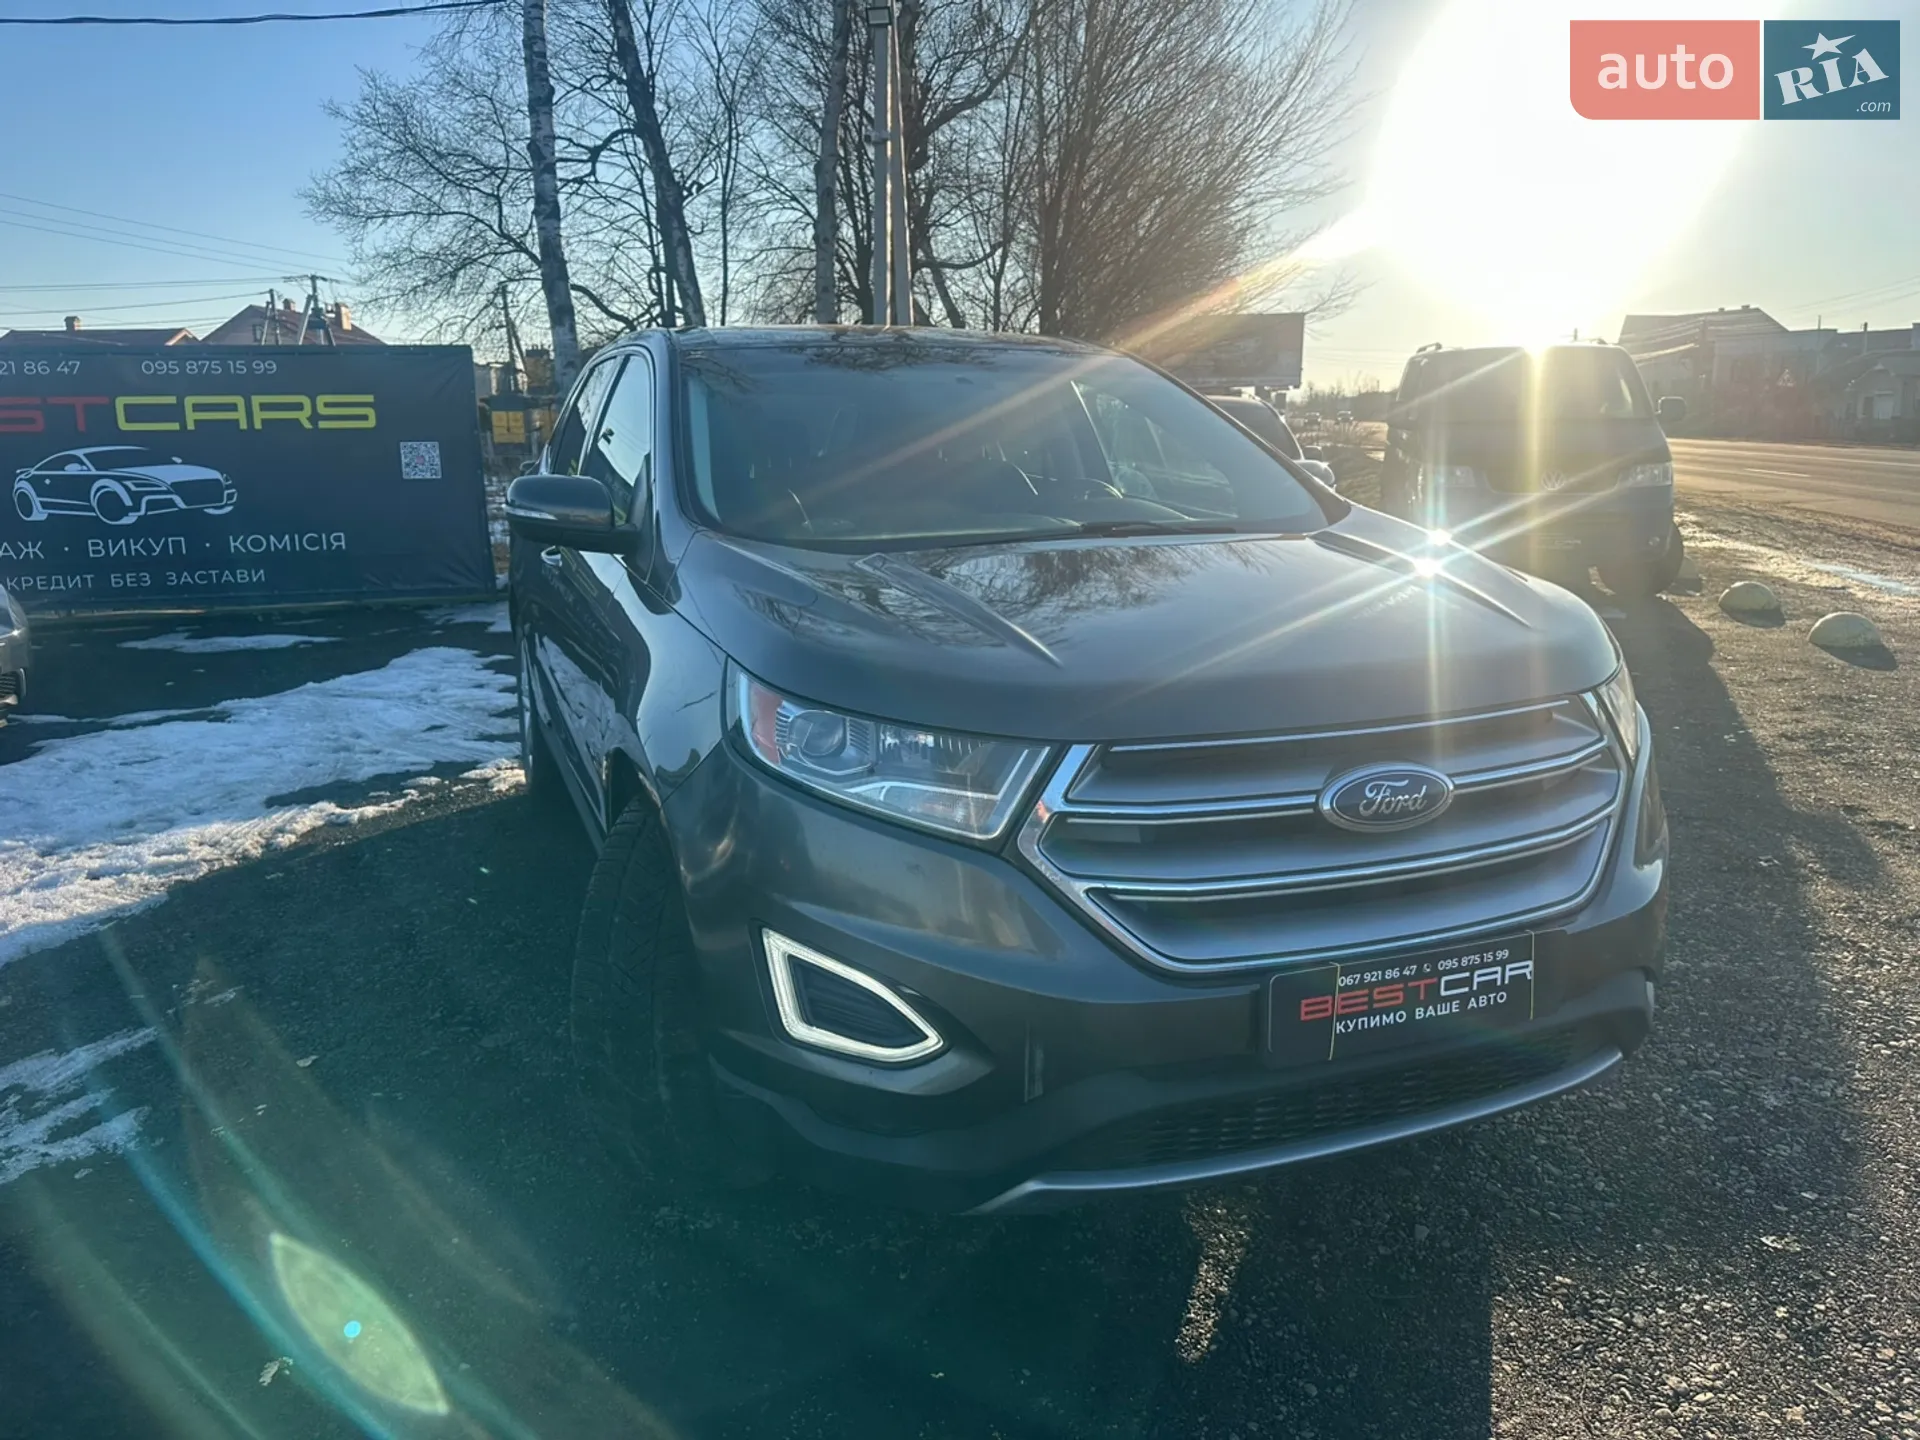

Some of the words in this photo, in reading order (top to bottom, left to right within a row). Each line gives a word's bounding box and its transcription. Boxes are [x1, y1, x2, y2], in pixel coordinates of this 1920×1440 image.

[23, 360, 50, 375] 86
[56, 360, 80, 375] 47
[141, 360, 180, 374] 095
[185, 360, 222, 374] 875
[227, 360, 247, 374] 15
[252, 360, 278, 374] 99
[87, 537, 187, 558] ВИКУП
[229, 532, 346, 554] КОМІСІЯ
[6, 574, 95, 591] КРЕДИТ
[110, 572, 152, 588] БЕЗ
[166, 569, 266, 586] ЗАСТАВИ
[1358, 779, 1428, 817] Ford
[1338, 973, 1360, 987] 067
[1363, 970, 1382, 983] 921
[1384, 967, 1401, 980] 86
[1402, 964, 1418, 976] 47
[1437, 957, 1459, 971] 095
[1461, 953, 1481, 967] 875
[1483, 951, 1494, 963] 15
[1495, 948, 1510, 960] 99
[1335, 1010, 1407, 1035] КУПИМО
[1414, 1000, 1461, 1020] ВАШЕ
[1467, 991, 1508, 1010] АВТО
